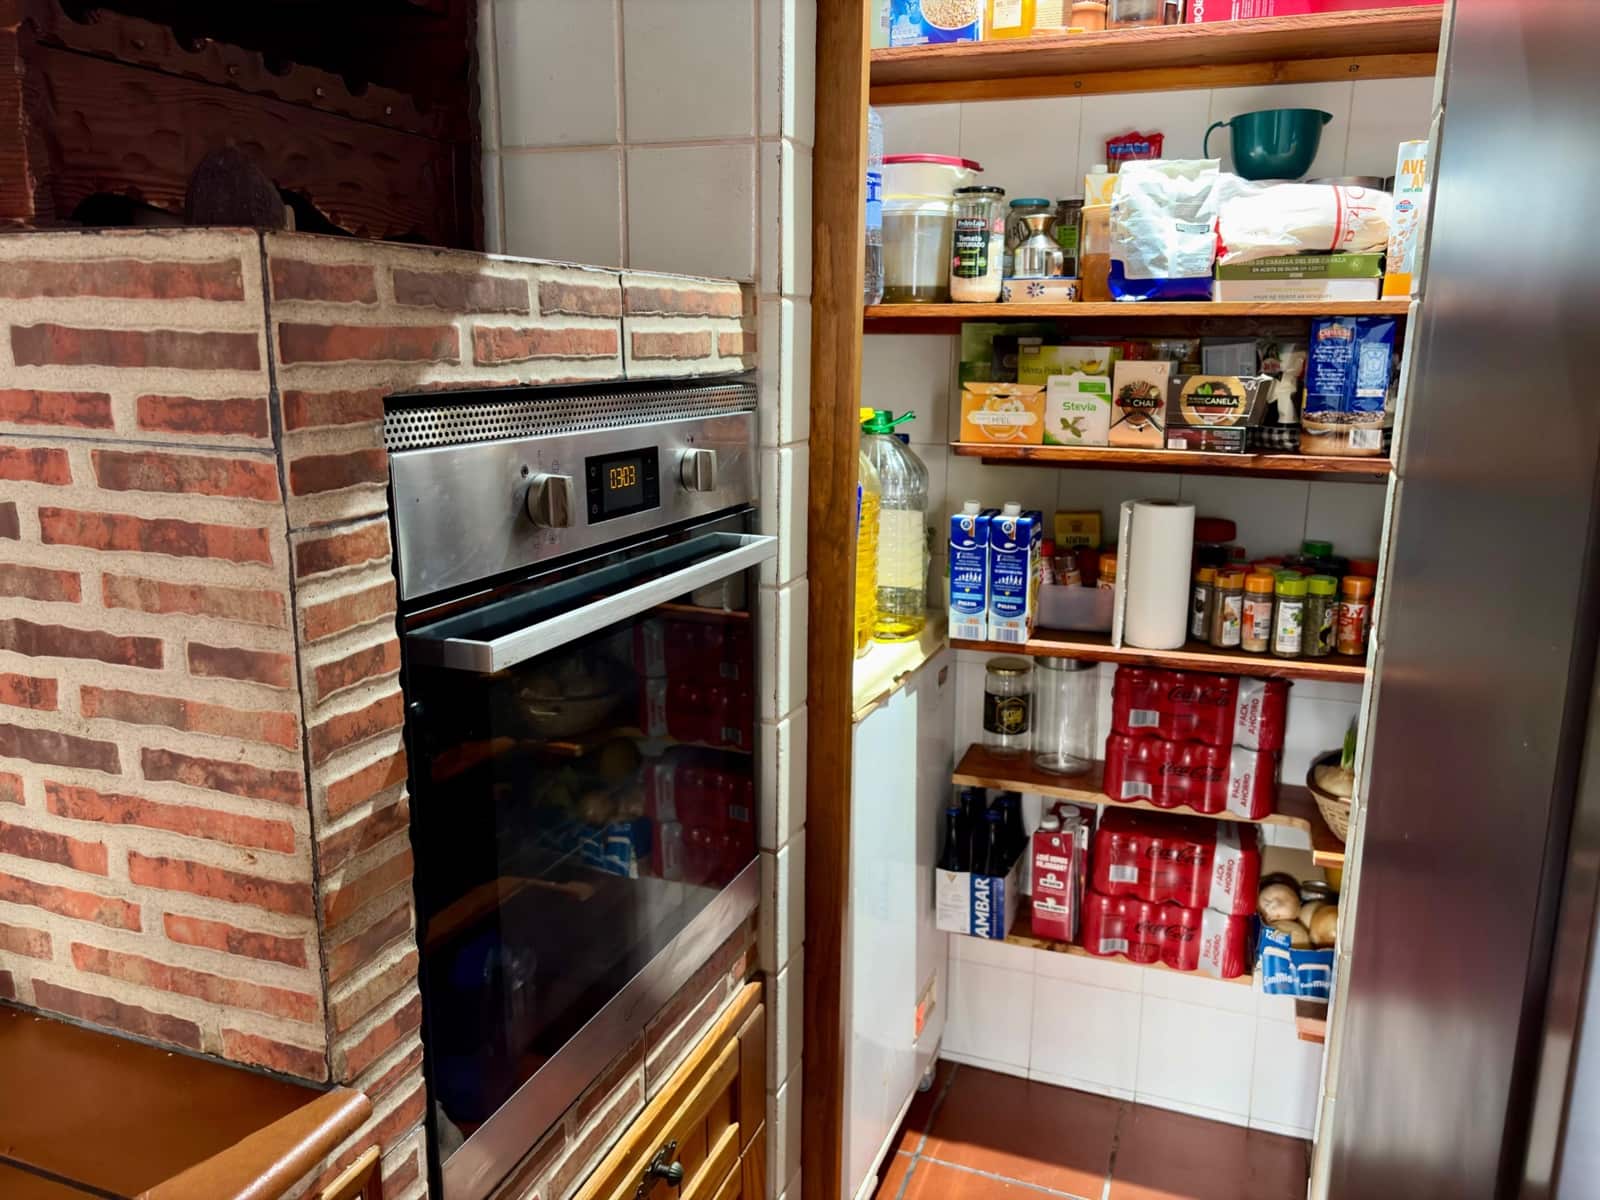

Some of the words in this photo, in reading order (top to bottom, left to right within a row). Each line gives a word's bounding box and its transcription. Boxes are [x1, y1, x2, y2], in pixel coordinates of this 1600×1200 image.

[1063, 401, 1097, 412] Stevia
[1132, 399, 1154, 407] CHAI
[1204, 396, 1238, 405] CANELA
[1239, 703, 1249, 727] PACK
[1248, 698, 1259, 735] AHORRO
[1232, 777, 1241, 799] PACK
[1240, 773, 1250, 808] AHORRO
[1224, 858, 1235, 895] AHORRO
[974, 877, 990, 938] AMBAR
[1211, 934, 1221, 968] AHORRO
